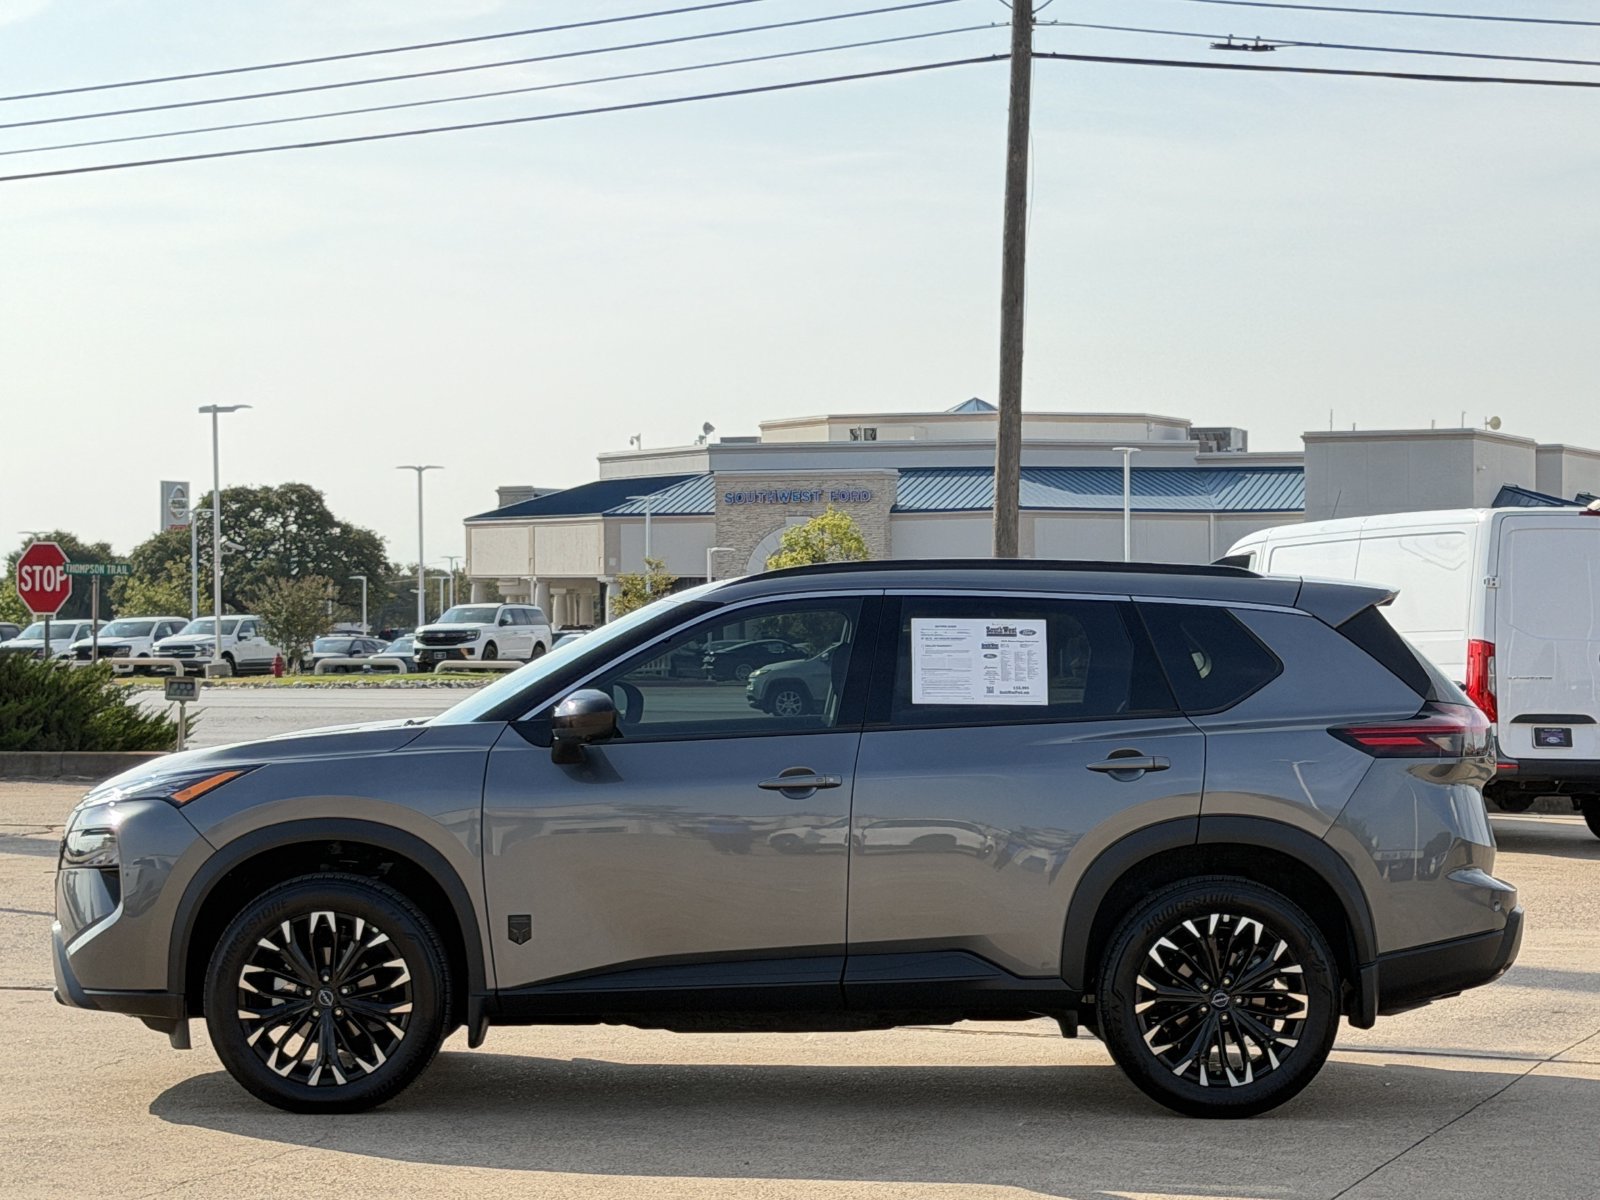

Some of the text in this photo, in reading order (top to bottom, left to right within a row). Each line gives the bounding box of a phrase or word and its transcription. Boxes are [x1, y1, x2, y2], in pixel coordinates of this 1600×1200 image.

[724, 488, 872, 505] SOUTHWEST FORD
[66, 563, 129, 575] THOMPSON TRAIL
[20, 565, 67, 592] STOP
